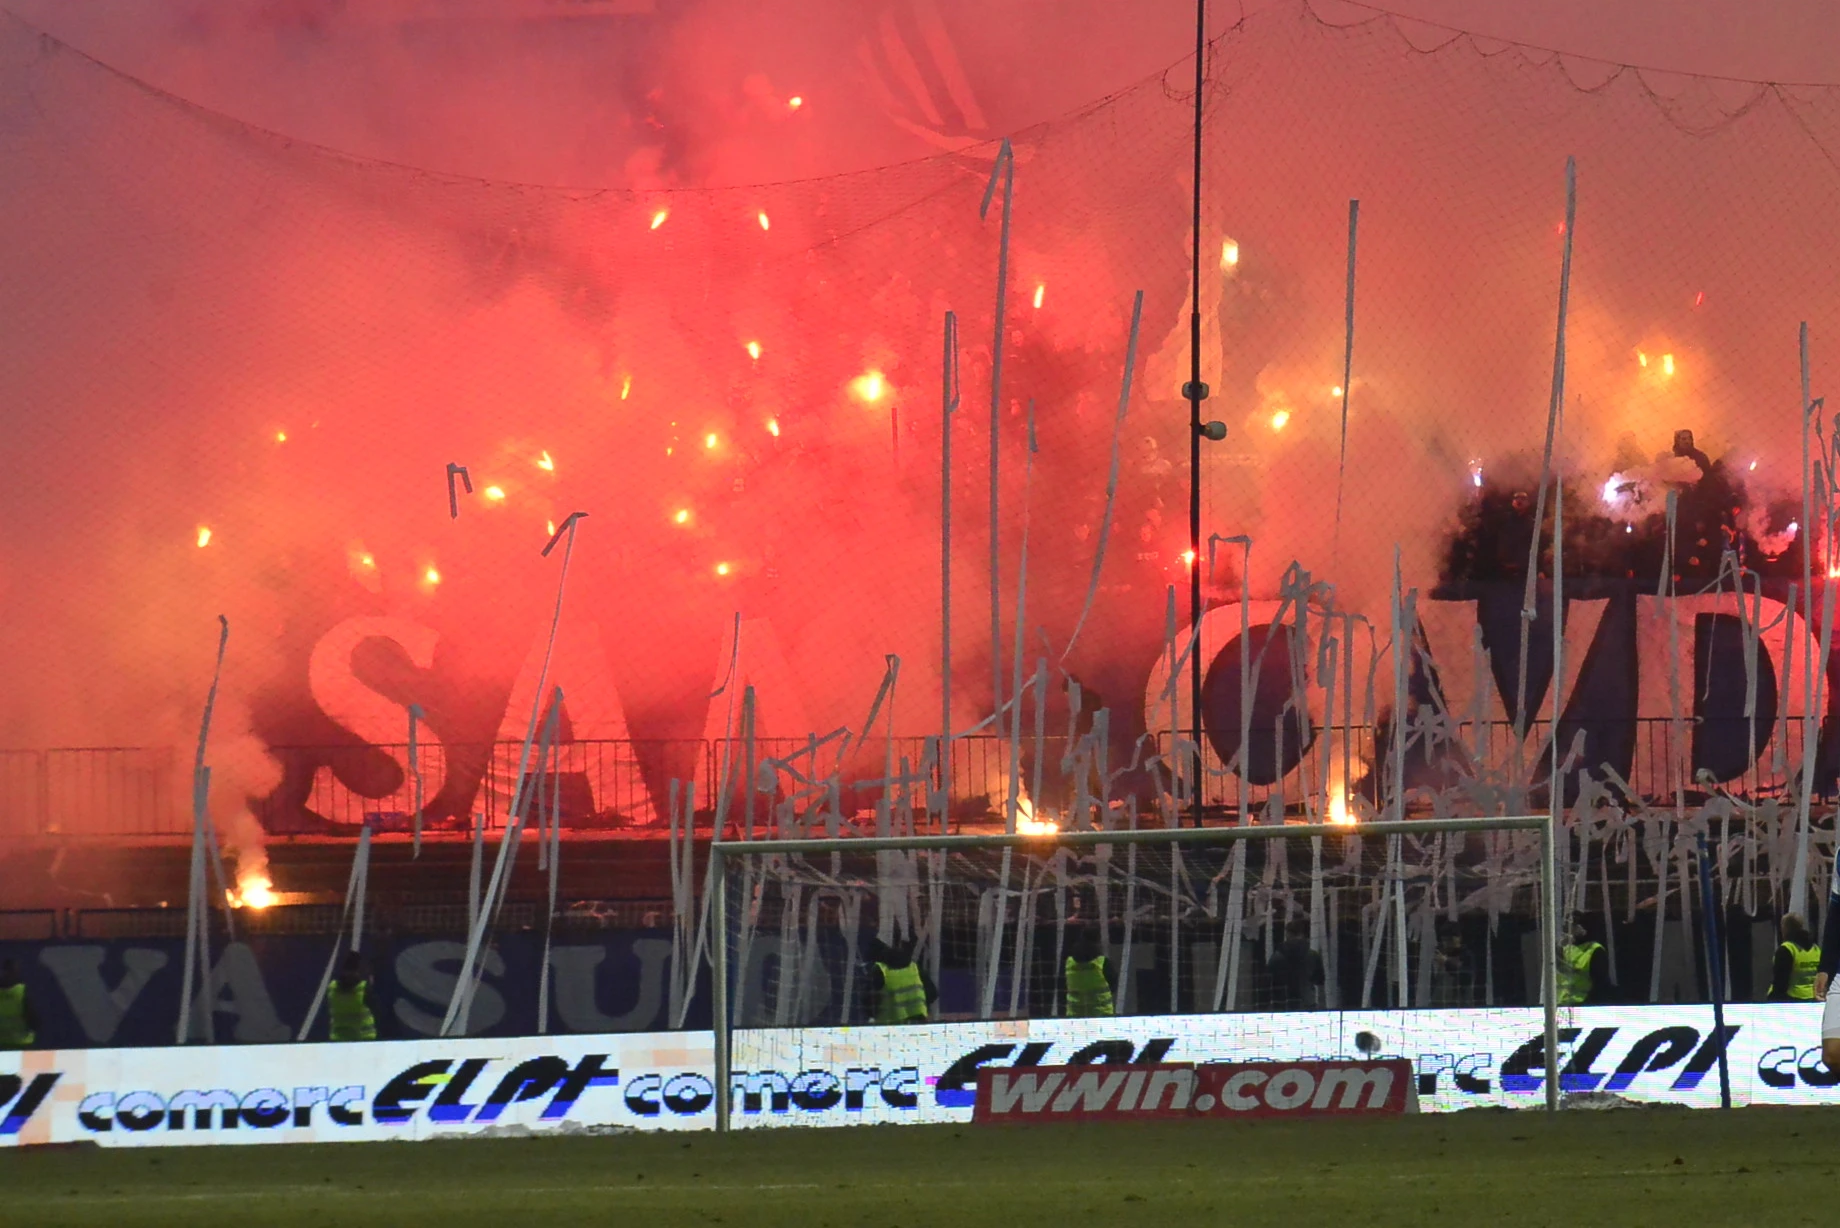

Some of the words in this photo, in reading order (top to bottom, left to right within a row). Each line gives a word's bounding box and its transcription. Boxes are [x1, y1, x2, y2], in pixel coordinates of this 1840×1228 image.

[78, 1085, 366, 1132] comerc
[624, 1066, 918, 1117] comerc
[1500, 1025, 1744, 1092] ELPI
[991, 1067, 1394, 1113] wwin.com
